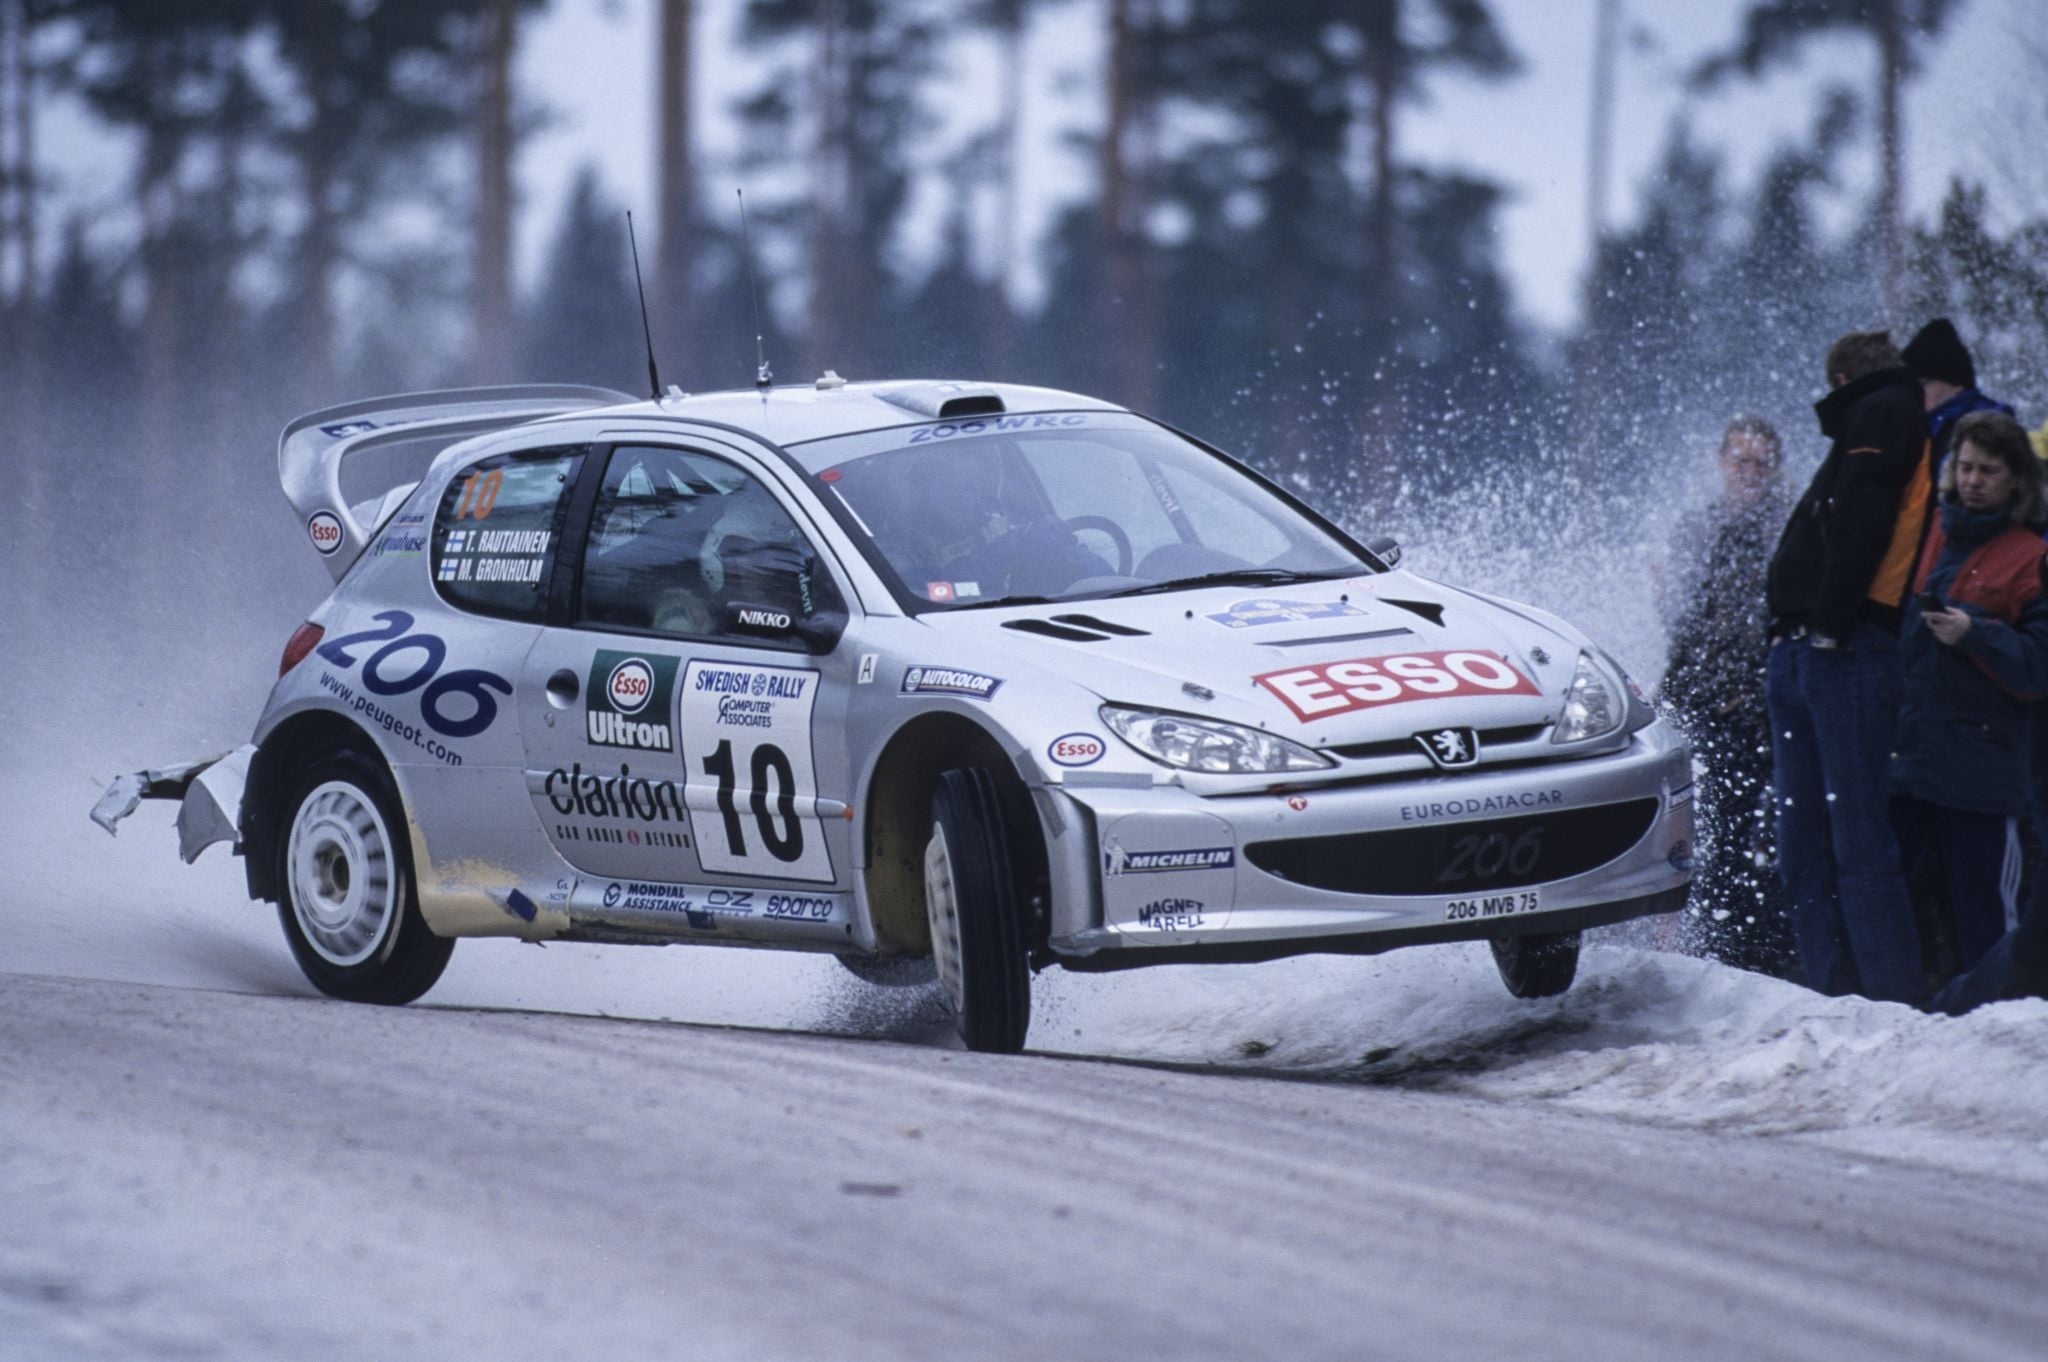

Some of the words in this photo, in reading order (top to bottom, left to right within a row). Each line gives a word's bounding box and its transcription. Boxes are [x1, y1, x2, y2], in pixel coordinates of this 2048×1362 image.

[909, 421, 986, 443] 206
[995, 414, 1087, 430] WRC
[456, 469, 504, 520] 10
[310, 523, 338, 541] Esso
[464, 531, 475, 551] T.
[478, 531, 550, 553] RAUTIAINEN
[457, 558, 473, 580] M.
[475, 558, 543, 582] GRONHOLM
[738, 610, 790, 628] NIKKO
[316, 610, 513, 737] 206
[860, 655, 872, 681] A
[920, 669, 993, 692] AUTOCOLOR
[615, 672, 647, 696] Esso
[696, 669, 751, 694] SWEDISH
[766, 675, 806, 699] RALLY
[1265, 652, 1520, 715] ESSO
[319, 671, 462, 766] www.peugeot.com
[716, 702, 772, 728] ASSOCIATES
[588, 710, 670, 749] Ultron
[1056, 742, 1098, 757] Esso
[702, 739, 805, 862] 10
[1401, 790, 1563, 821] EURODATACAR
[1130, 851, 1231, 868] MICHELIN
[1437, 825, 1545, 882] 206
[627, 883, 685, 898] MONDIAL
[622, 897, 692, 912] ASSISTANCE
[766, 895, 833, 920] sparco
[1447, 901, 1477, 919] 206
[1482, 896, 1515, 916] MVB
[1520, 892, 1538, 911] 75
